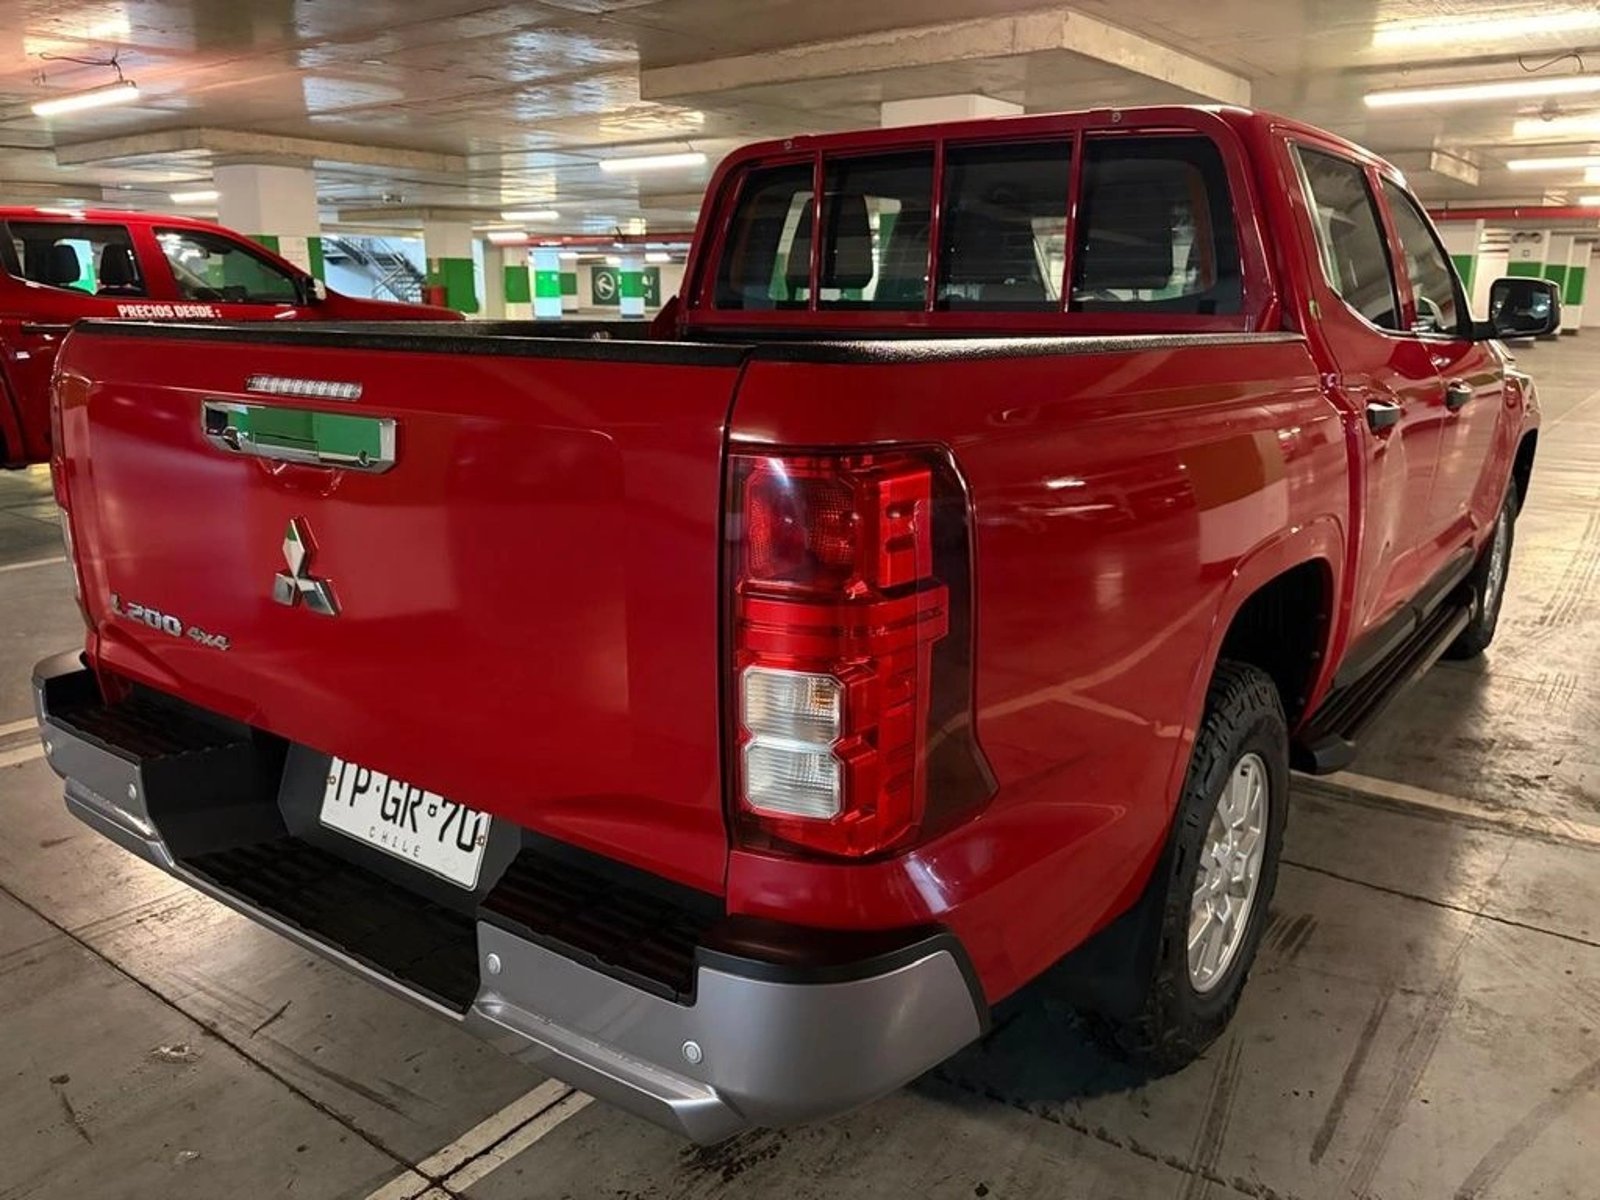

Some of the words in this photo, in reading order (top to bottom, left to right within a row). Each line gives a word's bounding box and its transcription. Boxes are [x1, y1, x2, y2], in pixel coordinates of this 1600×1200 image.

[117, 304, 174, 318] PRECIOS
[110, 593, 182, 637] L200
[369, 826, 421, 858] CHILE
